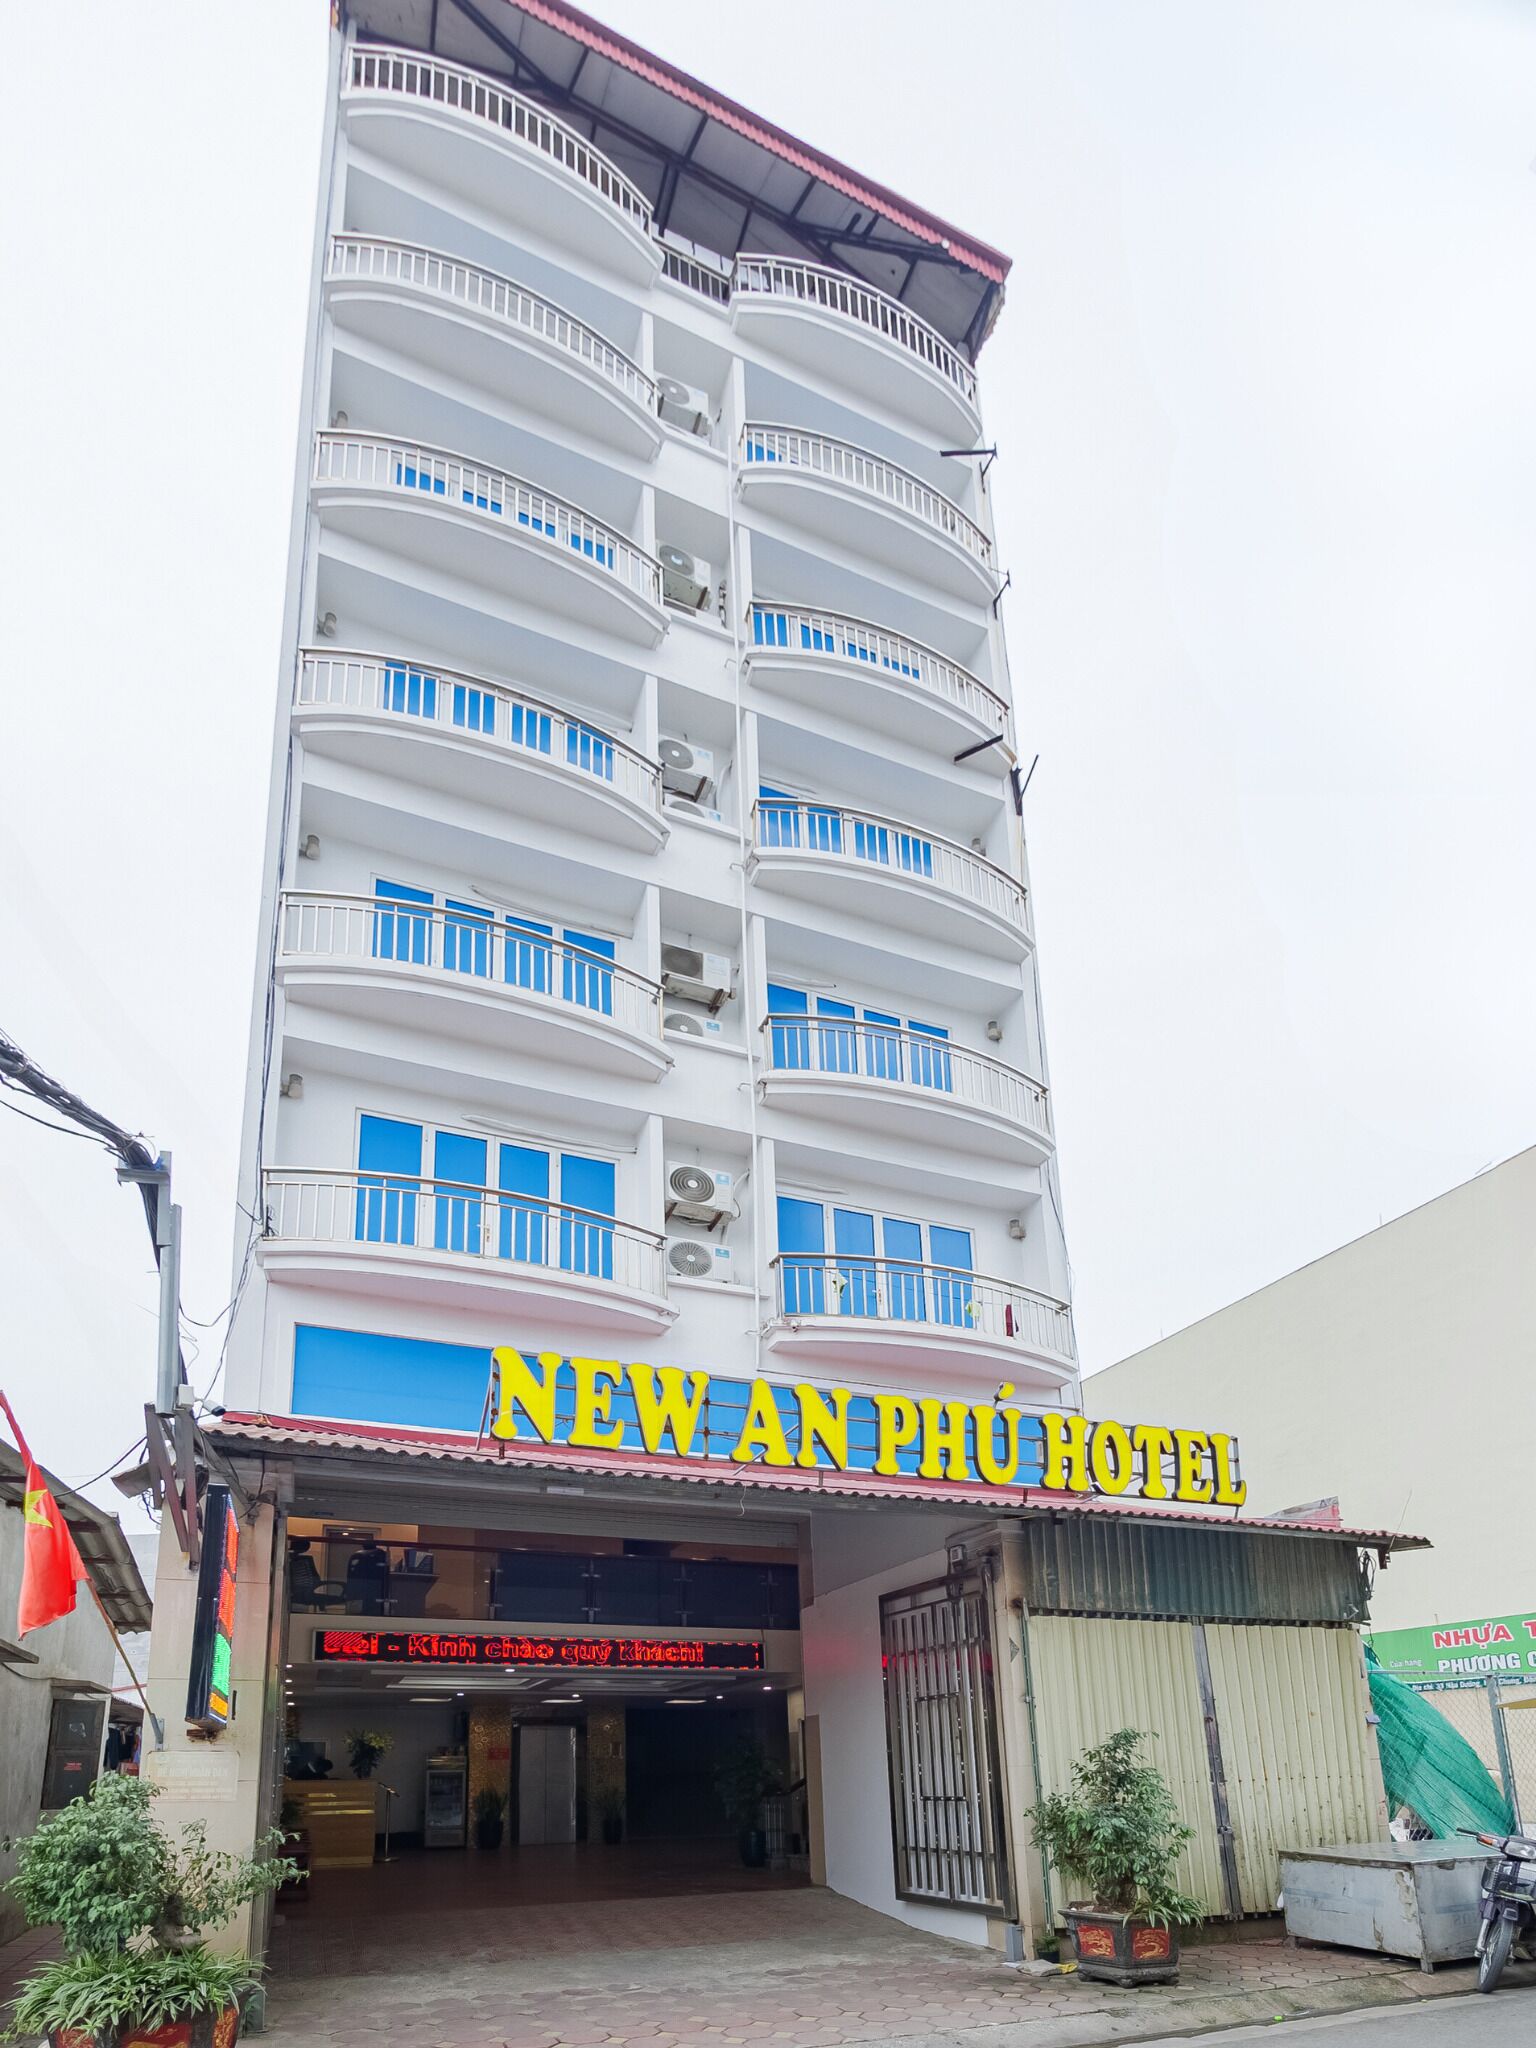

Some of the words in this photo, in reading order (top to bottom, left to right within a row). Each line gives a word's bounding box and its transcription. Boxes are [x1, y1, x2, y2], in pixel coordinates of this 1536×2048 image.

[493, 1346, 709, 1456] NEW
[733, 1378, 851, 1470] AN
[875, 1382, 1022, 1485] PHÚ
[1043, 1413, 1248, 1506] HOTEL
[1433, 1622, 1513, 1649] NHỰA
[485, 1637, 554, 1659] chào
[561, 1640, 613, 1664] quý
[619, 1641, 705, 1663] khách!
[1437, 1651, 1521, 1673] PHƯƠNG
